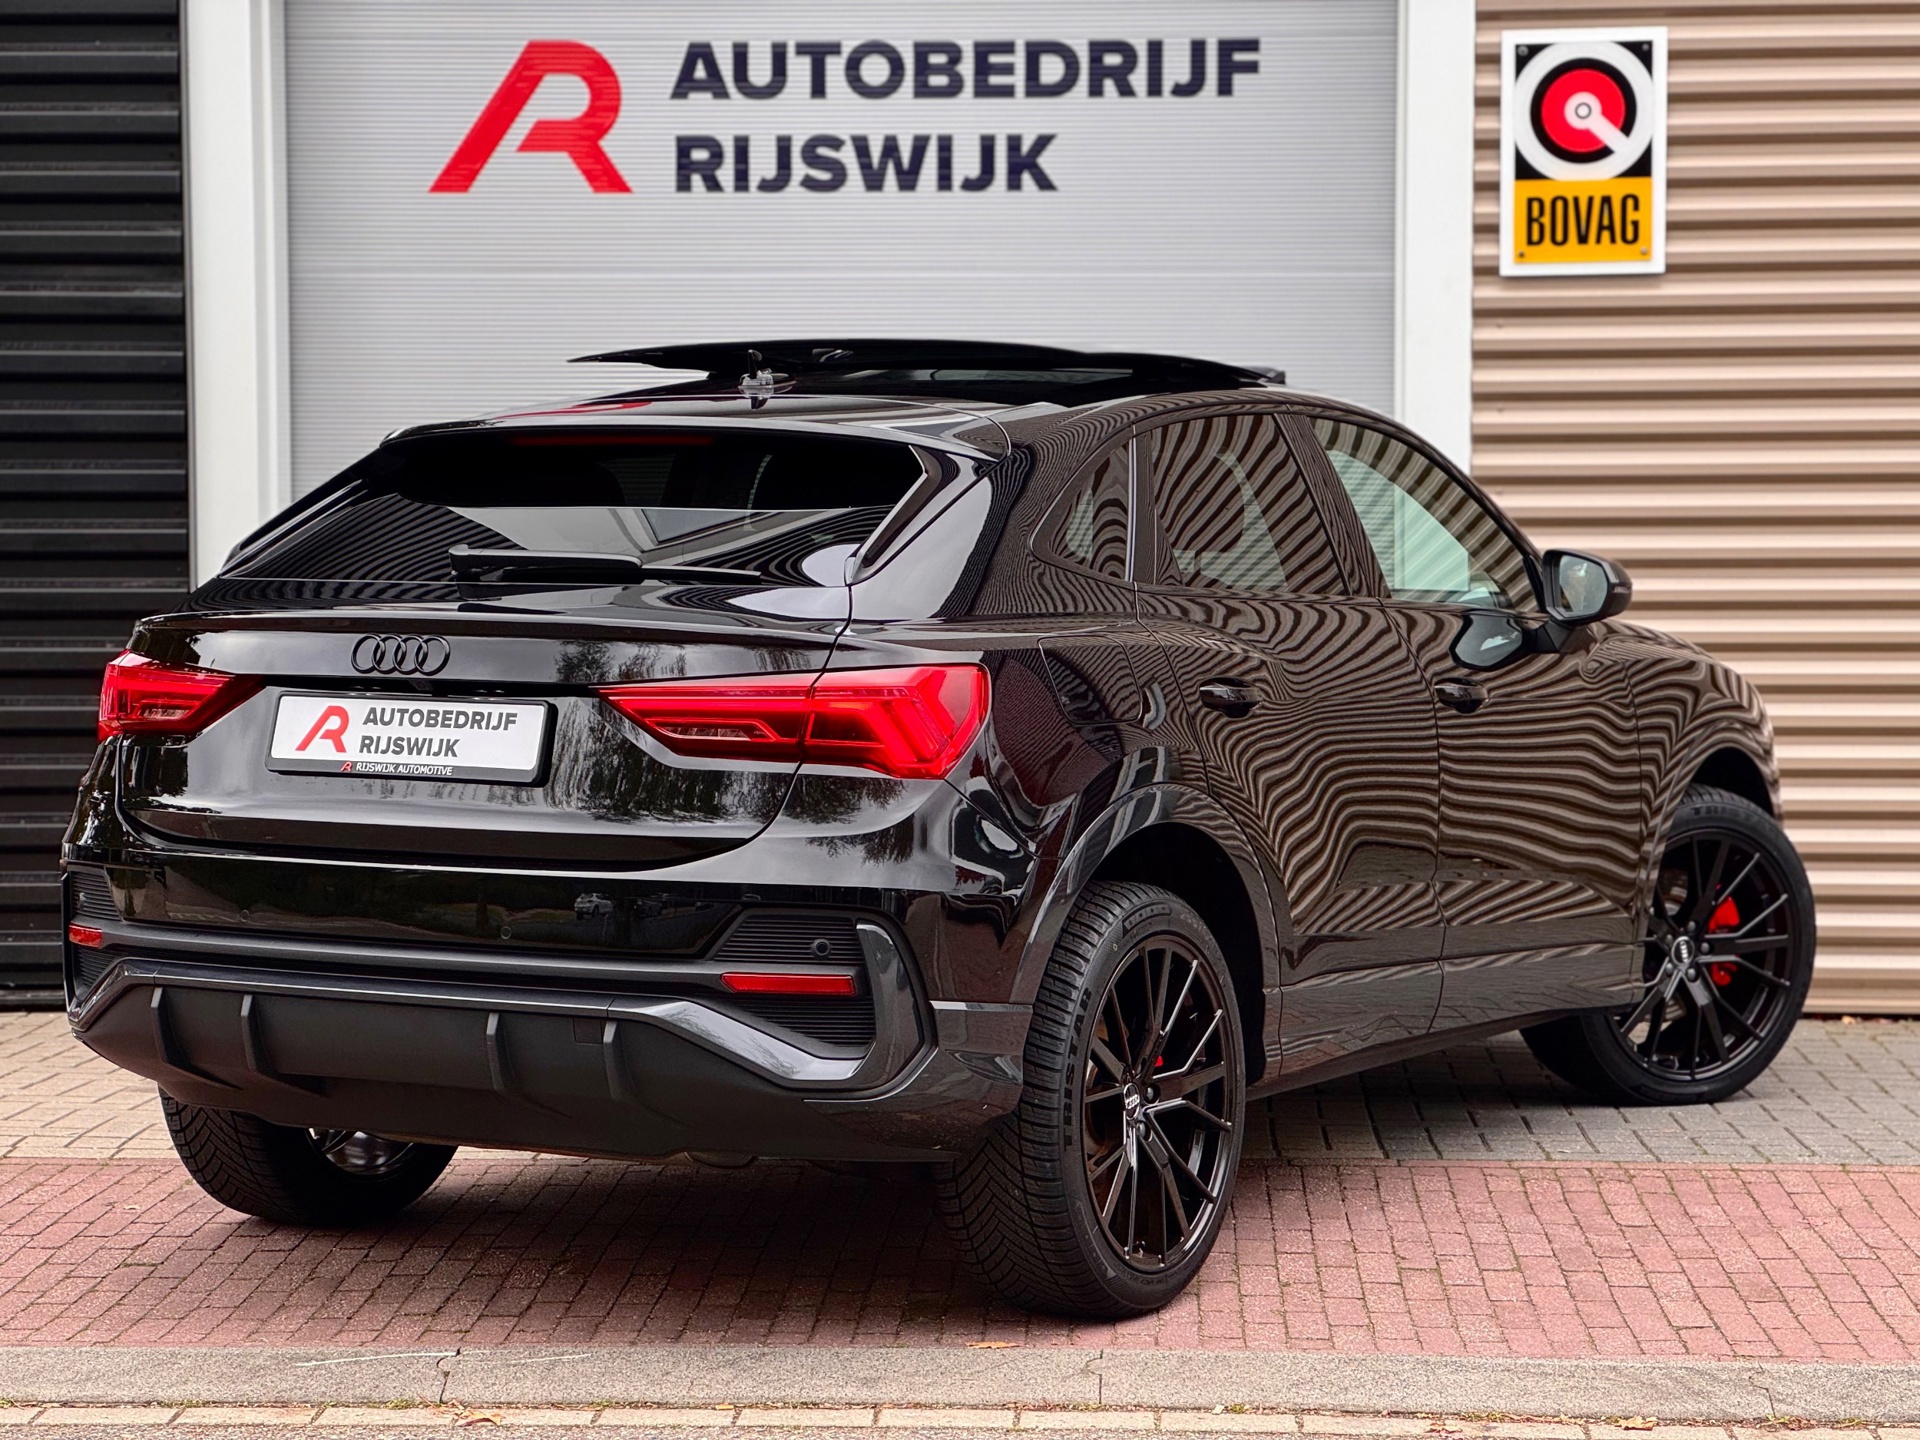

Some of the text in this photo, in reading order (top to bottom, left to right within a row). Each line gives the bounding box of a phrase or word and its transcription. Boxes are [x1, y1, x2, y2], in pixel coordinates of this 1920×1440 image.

[670, 38, 1260, 100] AUTOBEDRIJF
[674, 134, 1058, 193] RIJSWIJK
[1526, 194, 1640, 246] BOVAG
[362, 706, 518, 731] AUTOBEDRIJF
[356, 762, 395, 773] RIJSWIJK
[397, 765, 453, 776] AUTOMOTIVE
[358, 735, 461, 758] RIJSWIJK
[1063, 987, 1092, 1152] TRISTAR
